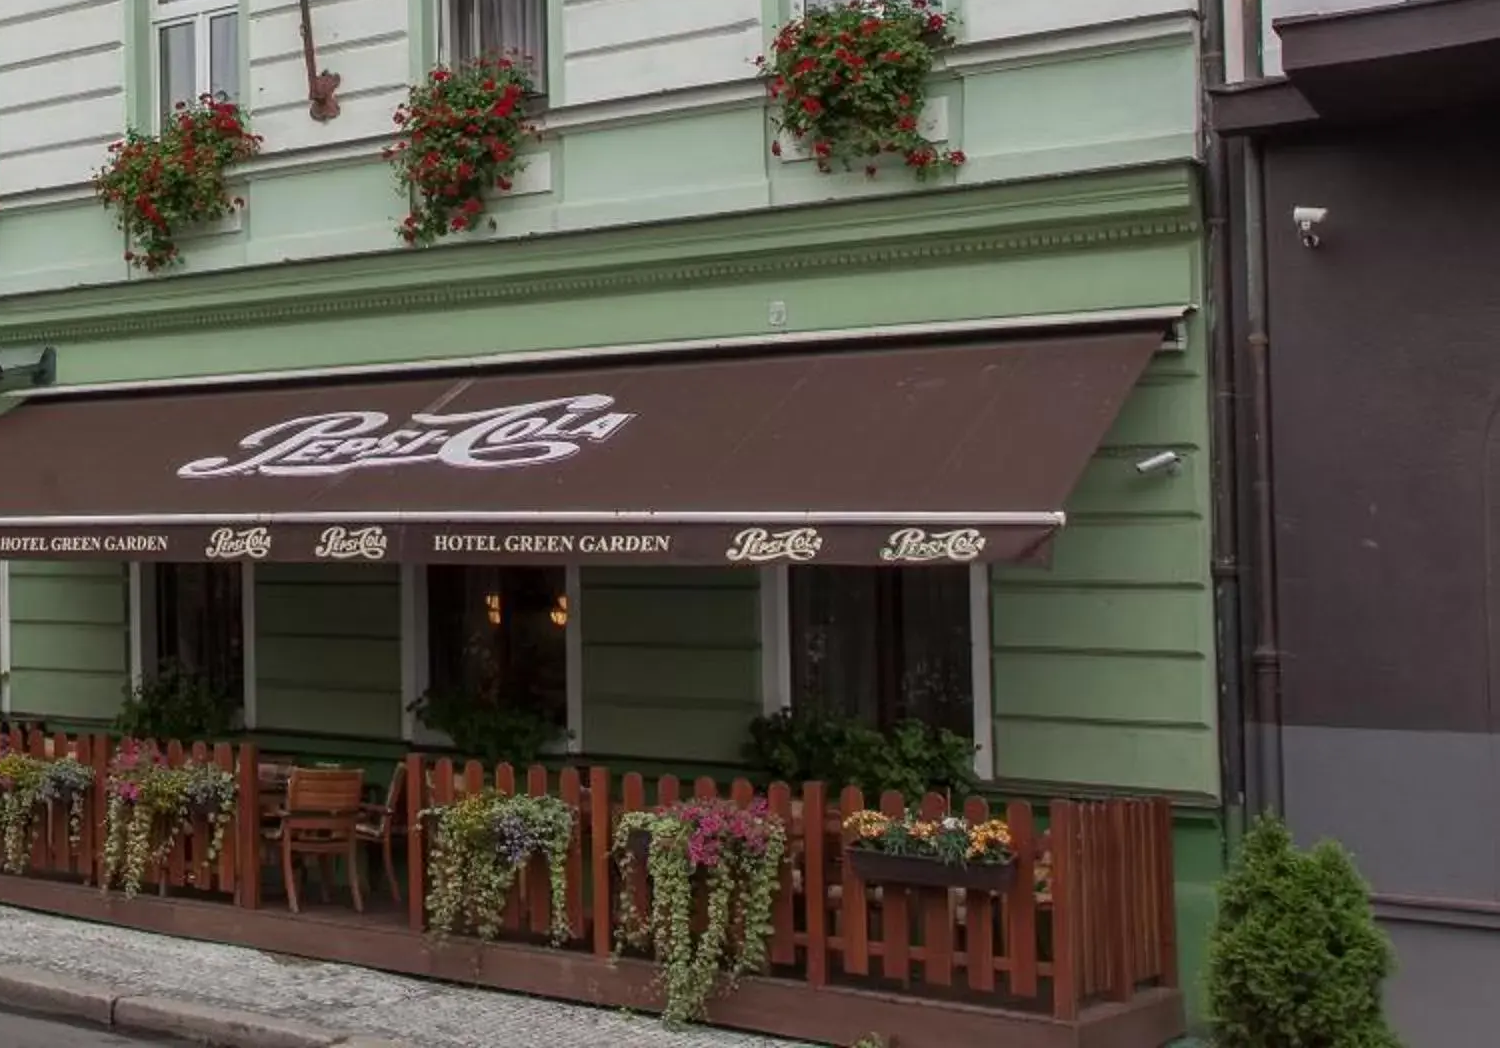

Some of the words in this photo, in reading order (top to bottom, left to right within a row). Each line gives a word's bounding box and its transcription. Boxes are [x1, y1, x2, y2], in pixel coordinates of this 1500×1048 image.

[0, 536, 49, 551] HOTEL
[51, 536, 102, 551] GREEN
[104, 535, 169, 551] GARDEN
[434, 534, 501, 552] HOTEL
[504, 535, 575, 552] GREEN
[578, 535, 671, 552] GARDEN
